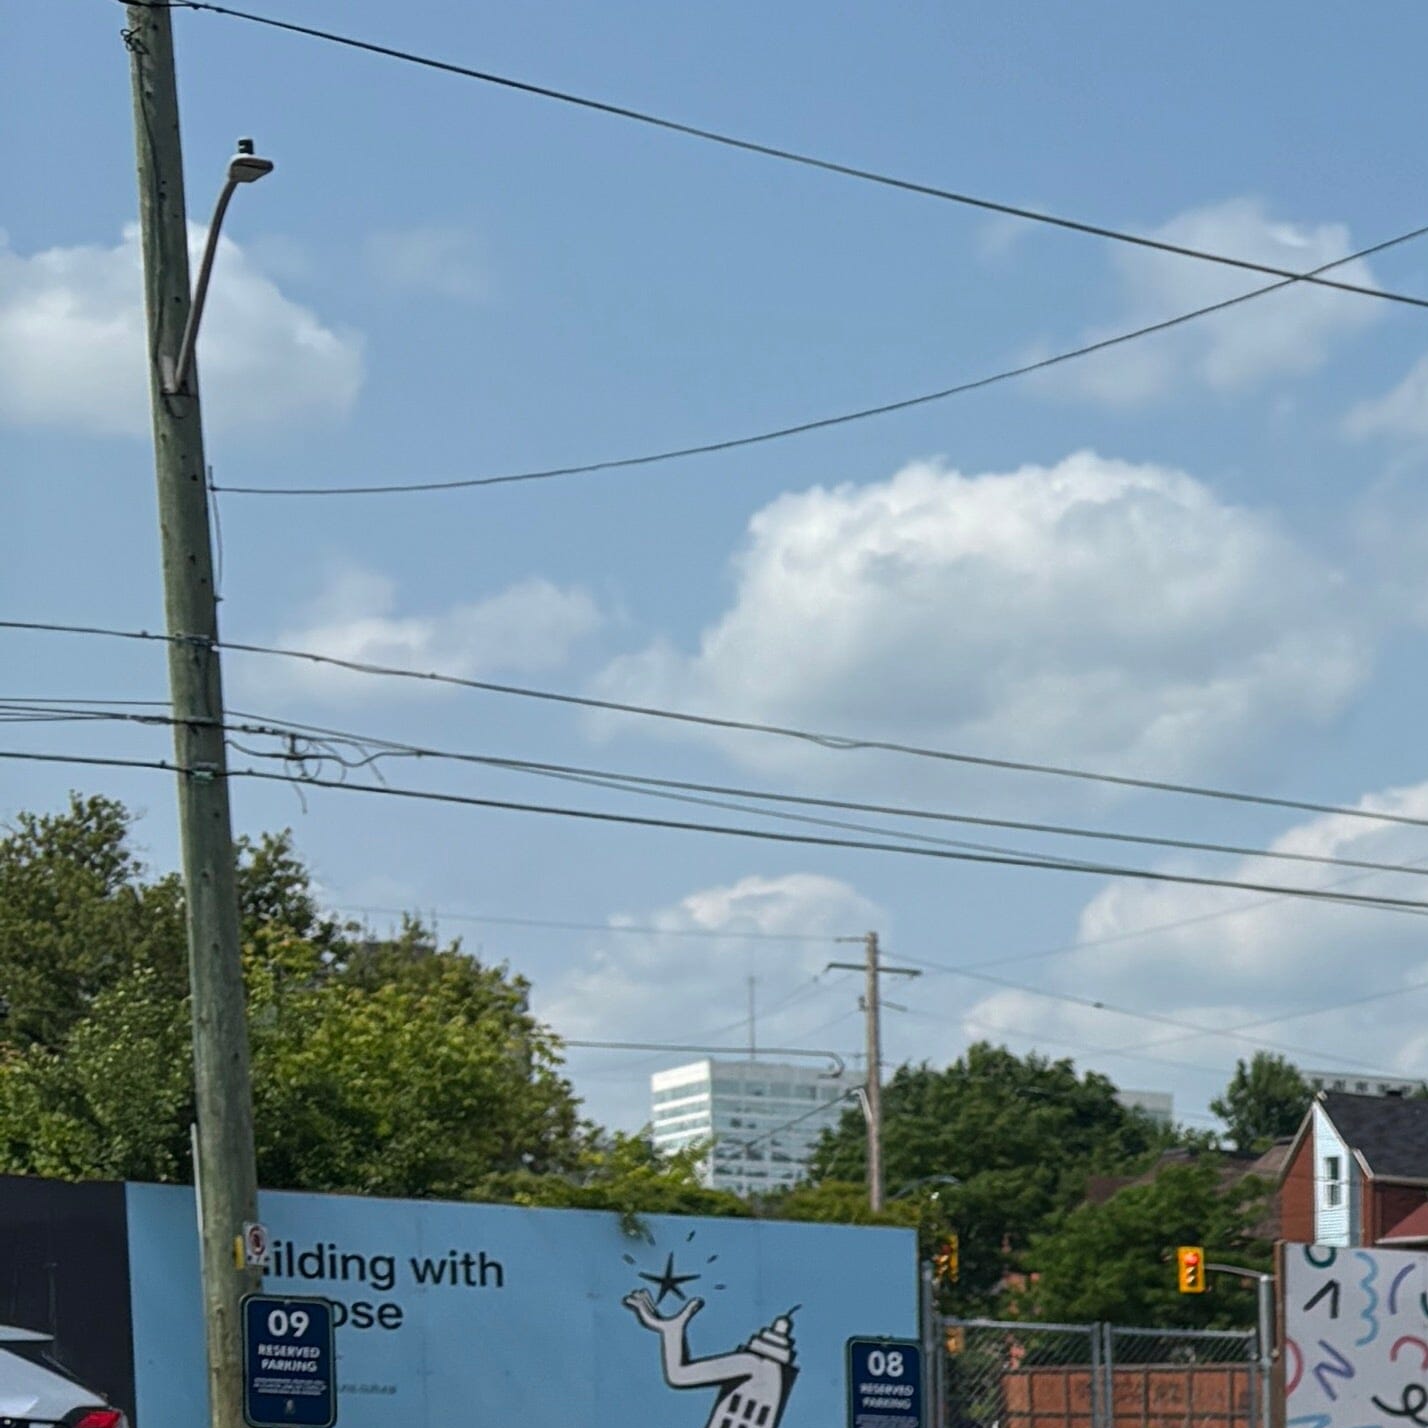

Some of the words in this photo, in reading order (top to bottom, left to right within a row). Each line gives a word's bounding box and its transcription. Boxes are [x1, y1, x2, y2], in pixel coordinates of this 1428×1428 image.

[263, 1240, 395, 1291] ilding
[410, 1250, 504, 1288] with
[267, 1310, 310, 1337] 09
[258, 1343, 320, 1358] RESERVED
[867, 1350, 904, 1377] 08
[261, 1359, 317, 1373] PARKING
